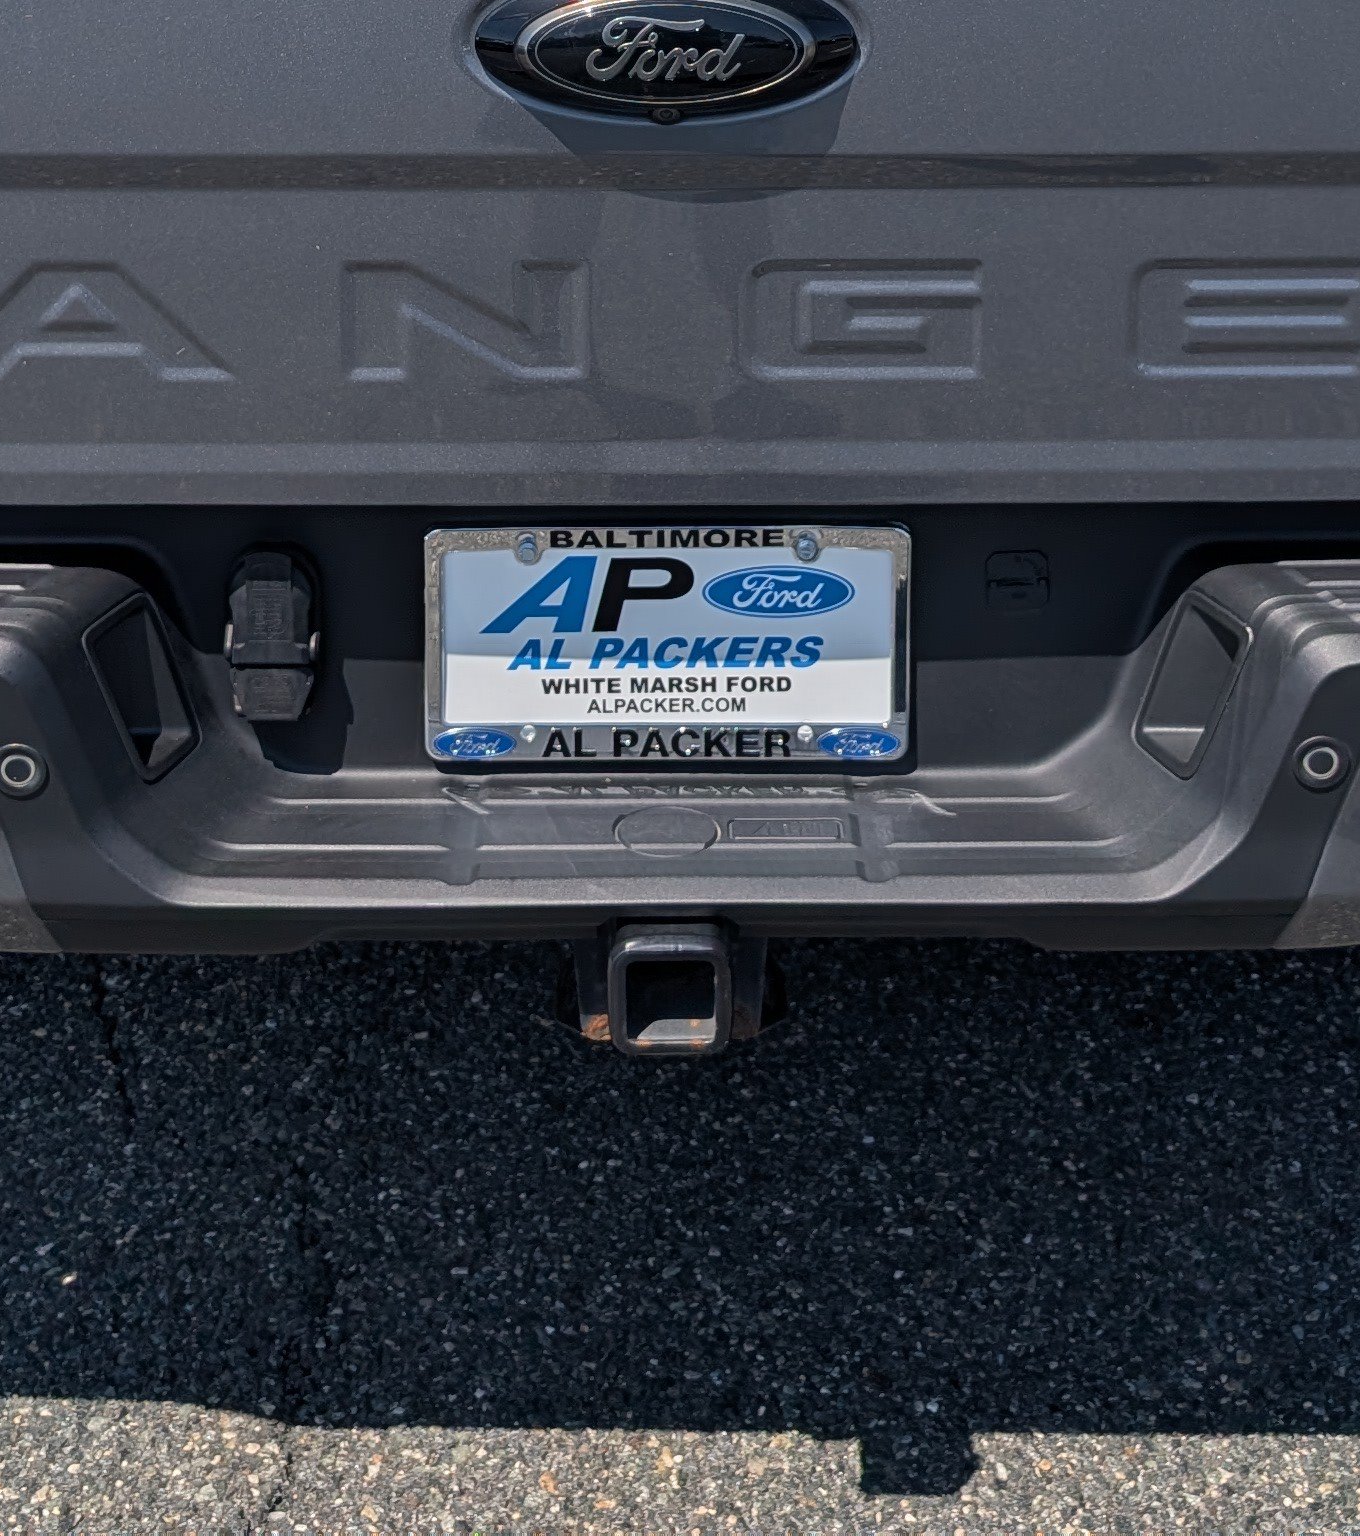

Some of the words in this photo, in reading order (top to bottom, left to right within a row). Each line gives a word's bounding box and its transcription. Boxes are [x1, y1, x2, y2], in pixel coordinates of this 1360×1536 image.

[585, 15, 745, 82] Ford
[549, 528, 785, 549] BALTIMORE
[479, 555, 695, 634] AP
[733, 574, 824, 609] Ford
[506, 638, 574, 671] AL
[588, 635, 824, 670] PACKERS
[541, 677, 621, 695] WHITE
[629, 676, 717, 694] MARSH
[726, 675, 792, 693] FORD
[586, 697, 746, 715] ALPACKER.COM
[450, 732, 500, 756] Ford
[542, 730, 597, 759] AL
[613, 729, 791, 759] PACKER
[834, 732, 884, 756] Ford
